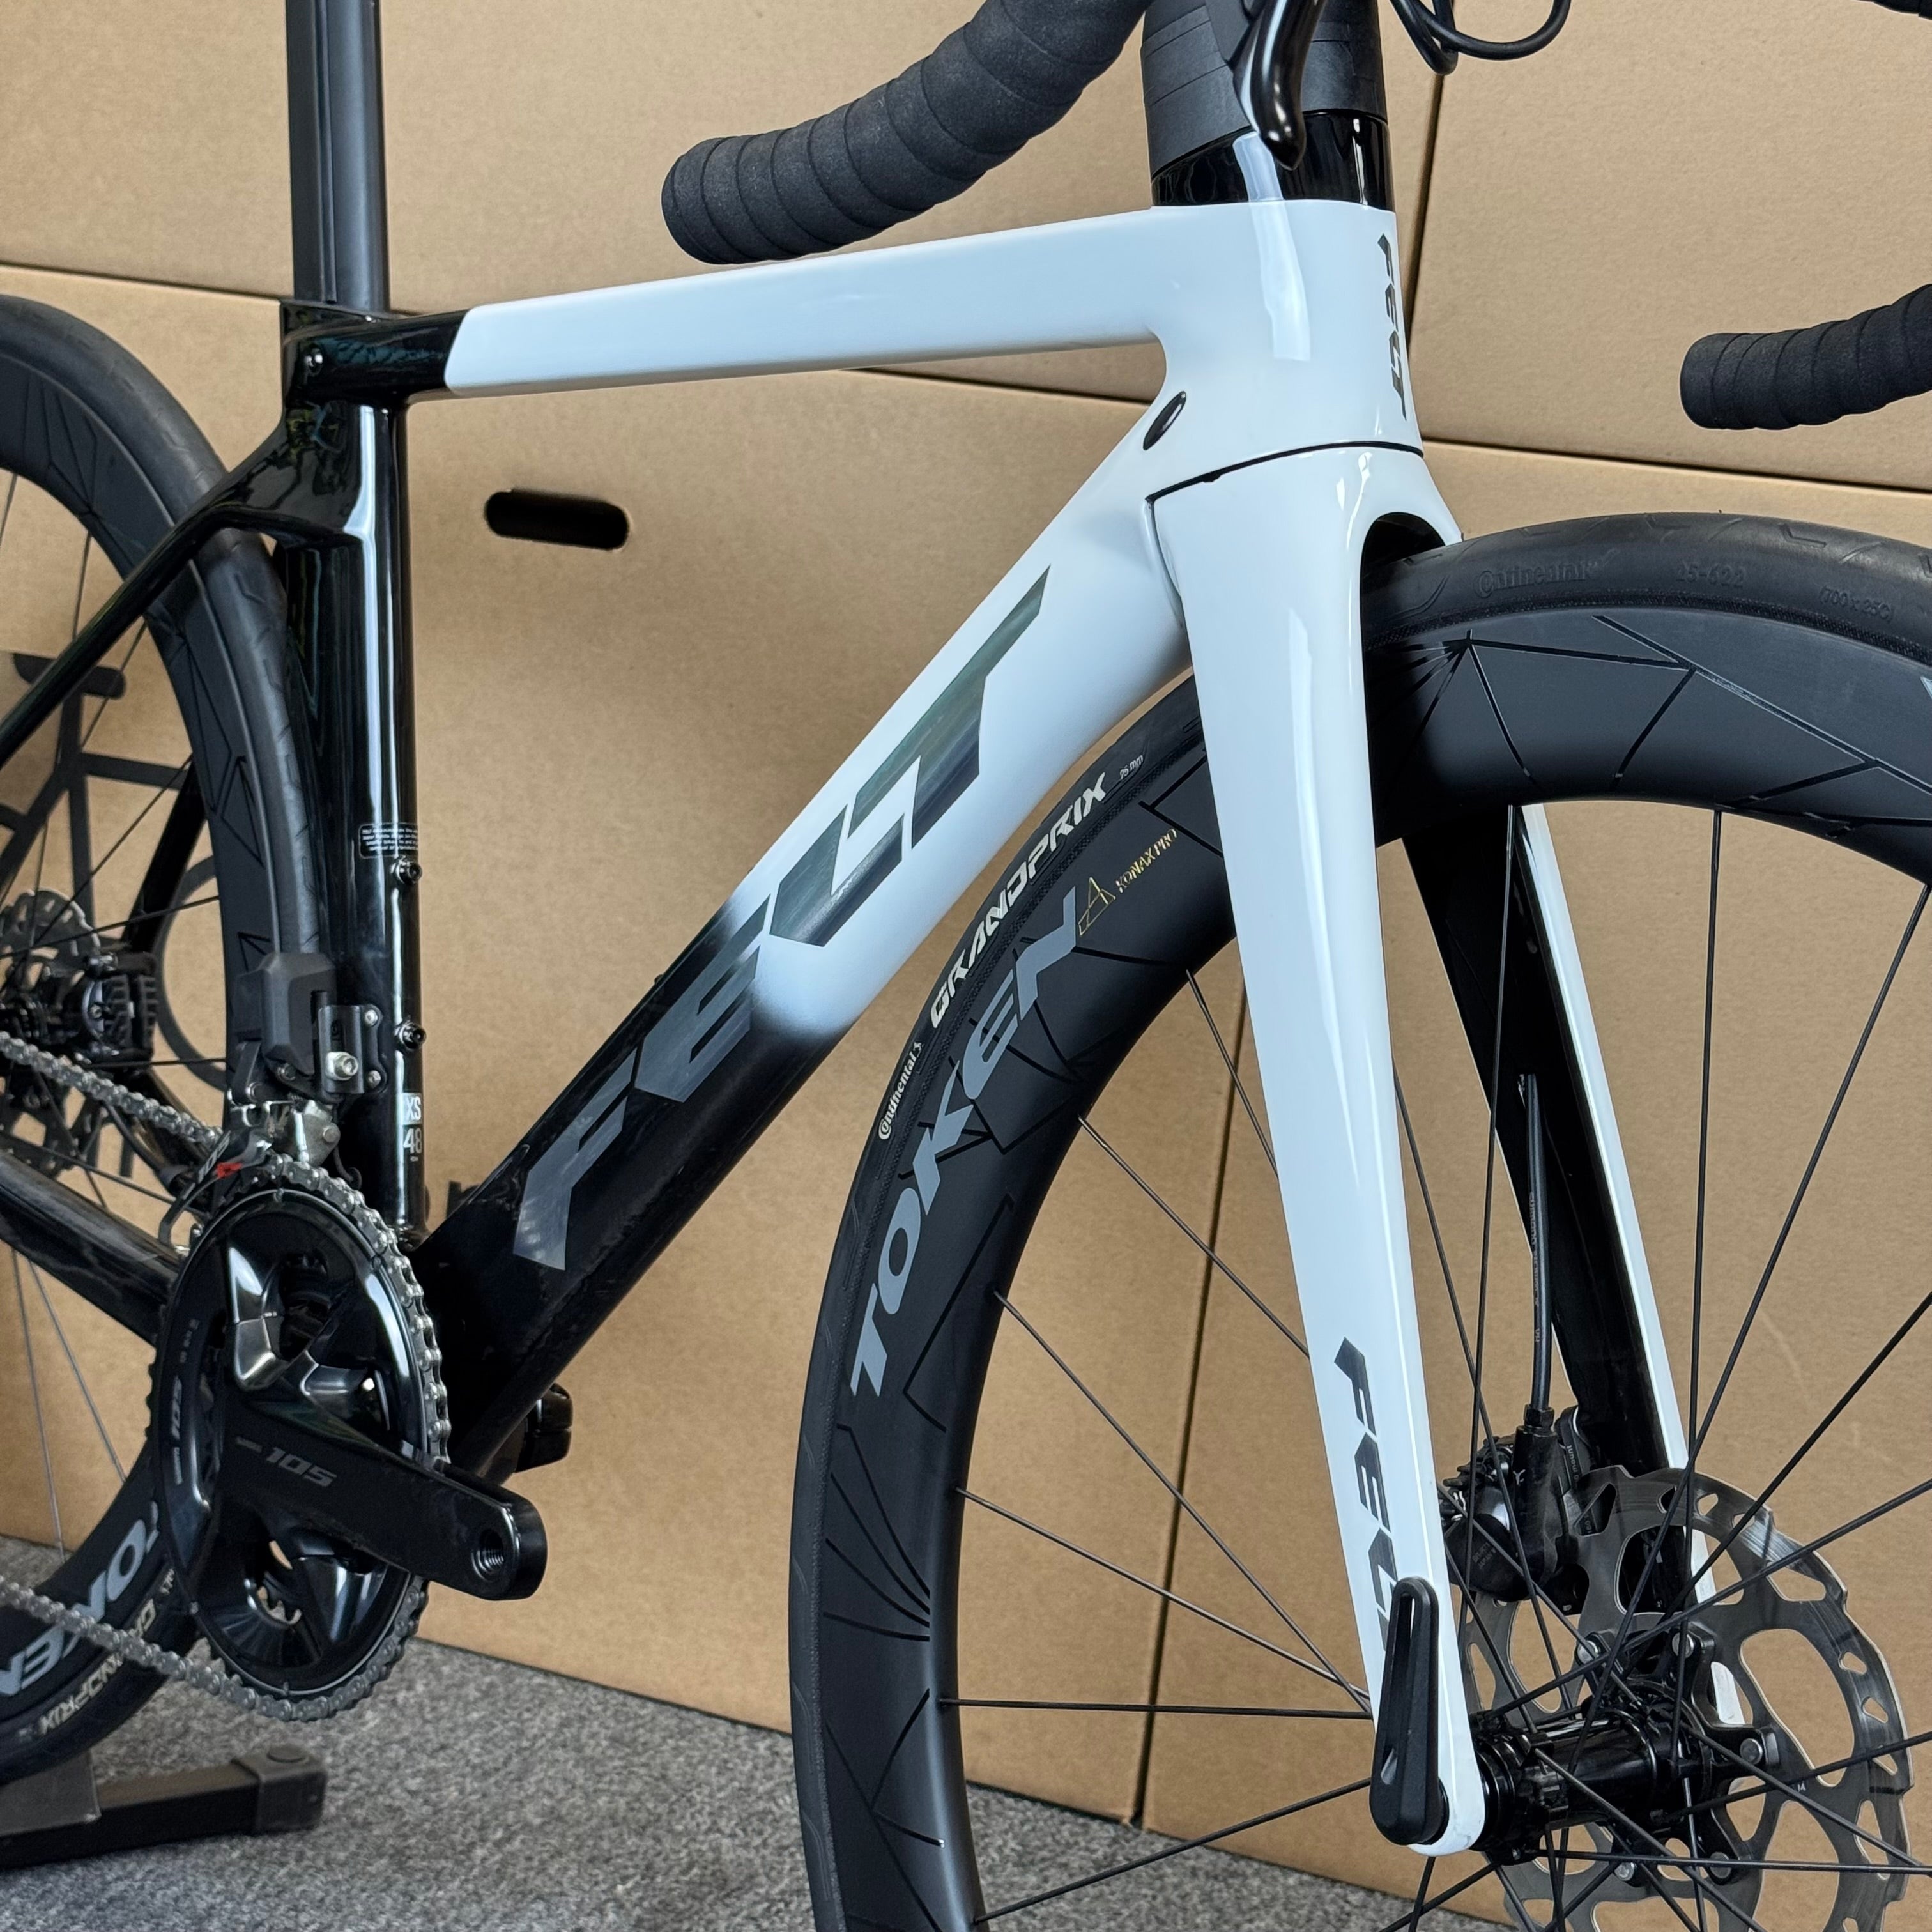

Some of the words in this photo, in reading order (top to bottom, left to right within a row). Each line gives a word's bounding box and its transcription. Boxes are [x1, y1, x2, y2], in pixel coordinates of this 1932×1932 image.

[1377, 233, 1407, 421] FELT
[514, 564, 1051, 1271] FELT
[930, 772, 1107, 1029] GRANDPRIX
[403, 1127, 422, 1154] 48
[406, 1096, 422, 1121] XS
[850, 885, 1077, 1397] TOKEN
[879, 1051, 917, 1140] Continental
[266, 1446, 338, 1487] 105
[1334, 1336, 1399, 1651] FEL
